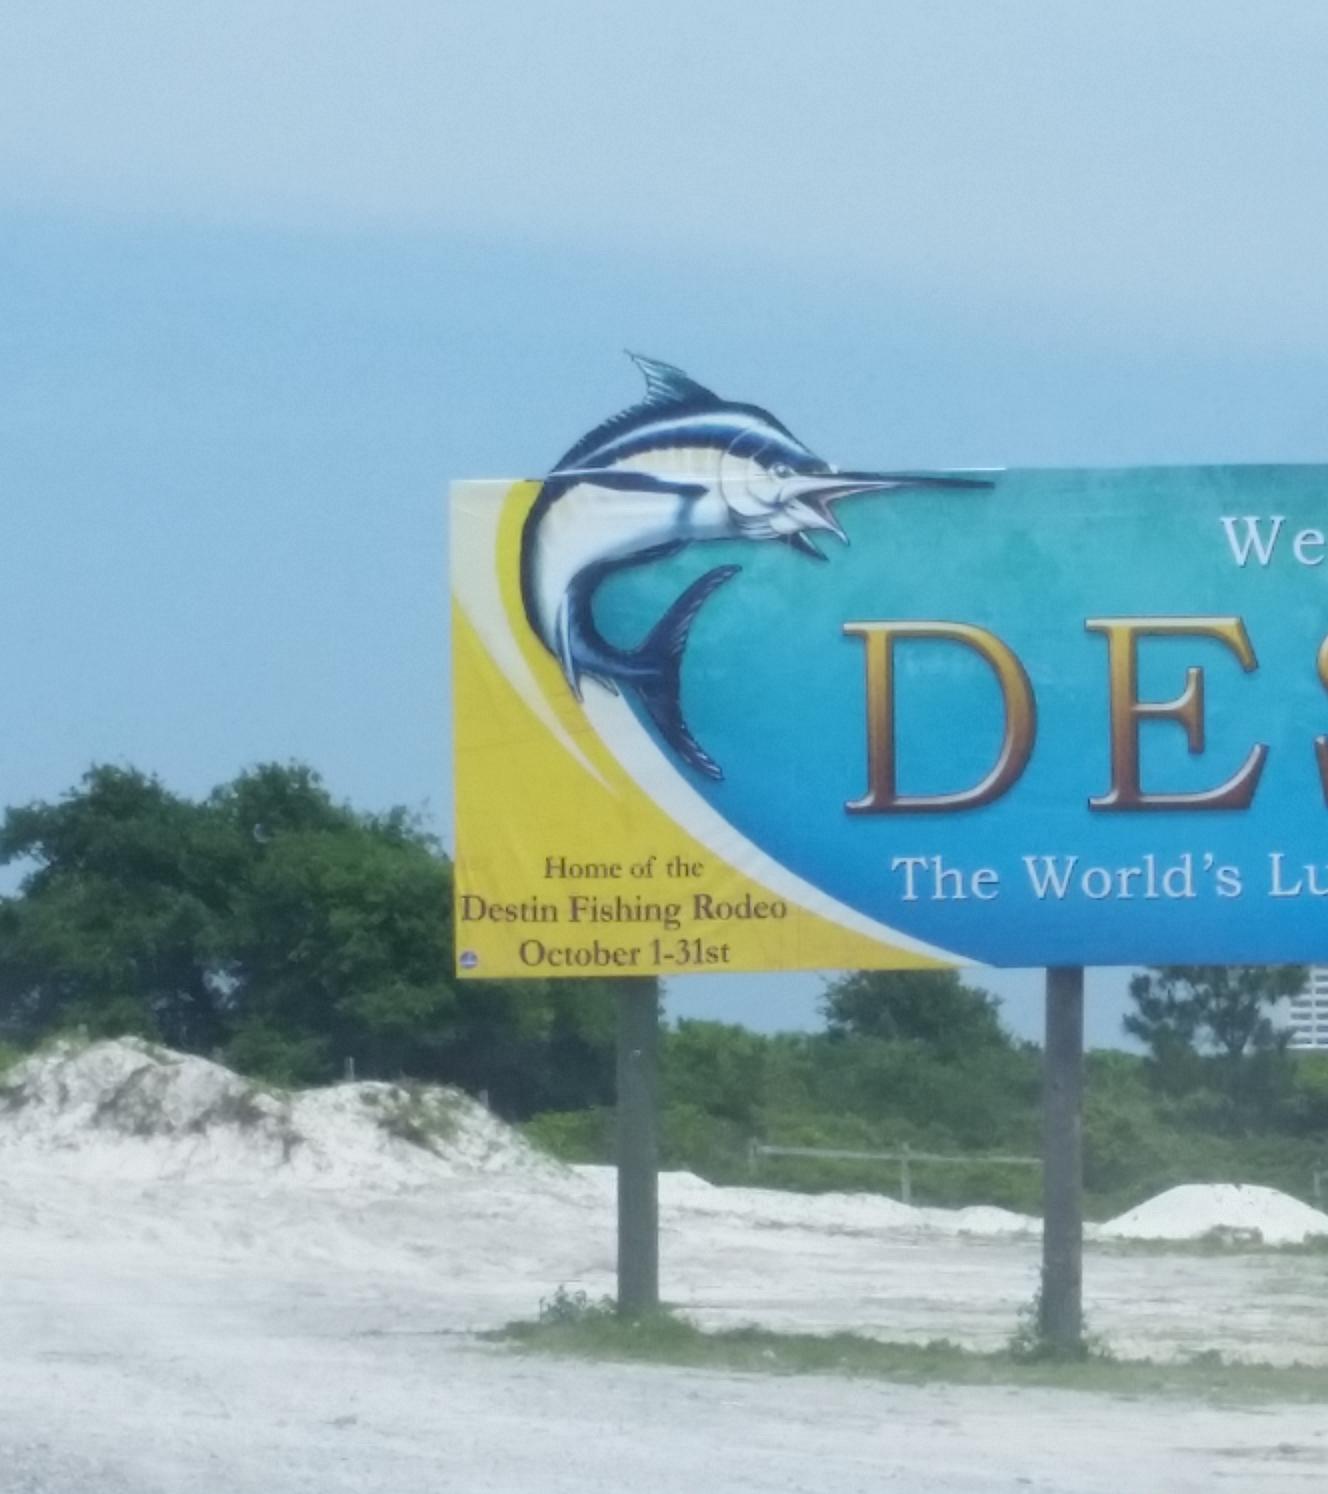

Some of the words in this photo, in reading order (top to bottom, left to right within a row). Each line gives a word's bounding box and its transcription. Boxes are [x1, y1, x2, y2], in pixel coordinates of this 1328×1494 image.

[543, 856, 622, 880] Home
[630, 856, 656, 879] of
[666, 856, 705, 878] the
[891, 854, 999, 901] The
[461, 895, 559, 923] Destin
[568, 894, 682, 930] Fishing
[692, 892, 788, 919] Rodeo
[518, 939, 641, 967] October
[650, 938, 731, 965] 1-31st
